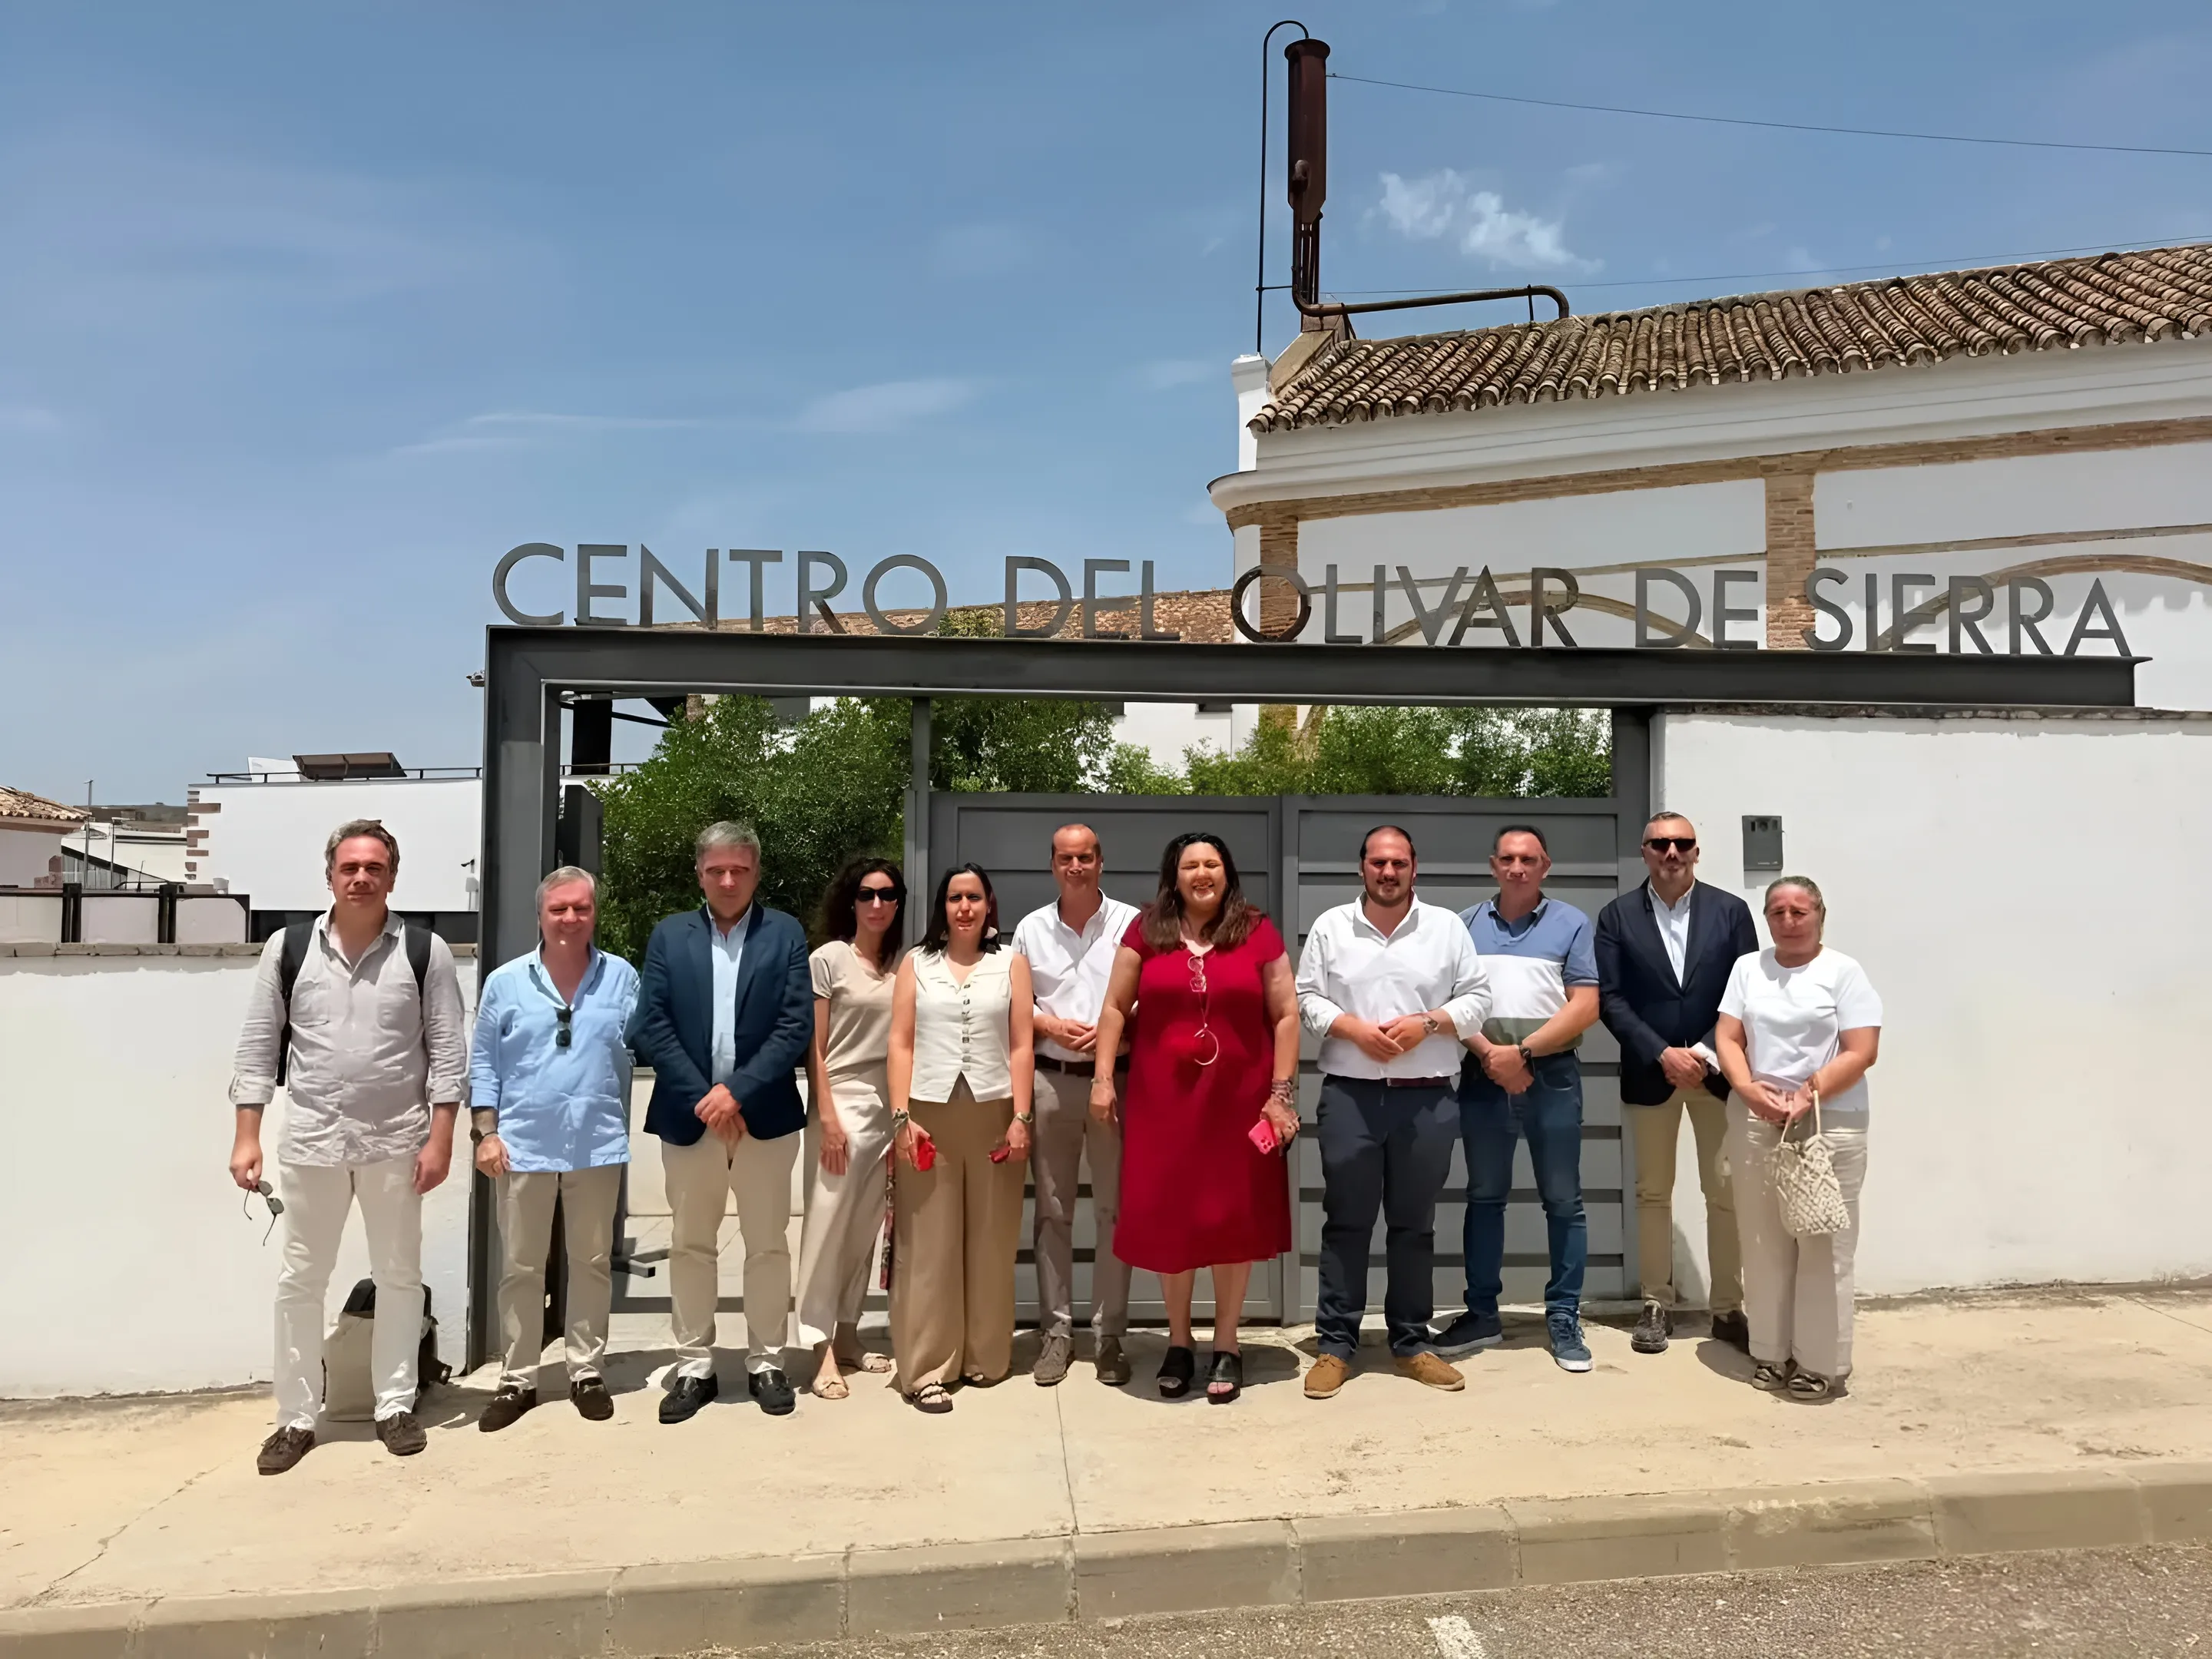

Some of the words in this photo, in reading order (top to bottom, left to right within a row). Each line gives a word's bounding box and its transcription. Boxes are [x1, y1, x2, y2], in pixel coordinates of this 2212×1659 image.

[492, 542, 948, 635] CENTRO
[1005, 555, 1181, 641] DEL
[1231, 564, 1579, 647] OLIVAR
[1634, 568, 1758, 650] DE
[1801, 568, 2132, 657] SIERRA
